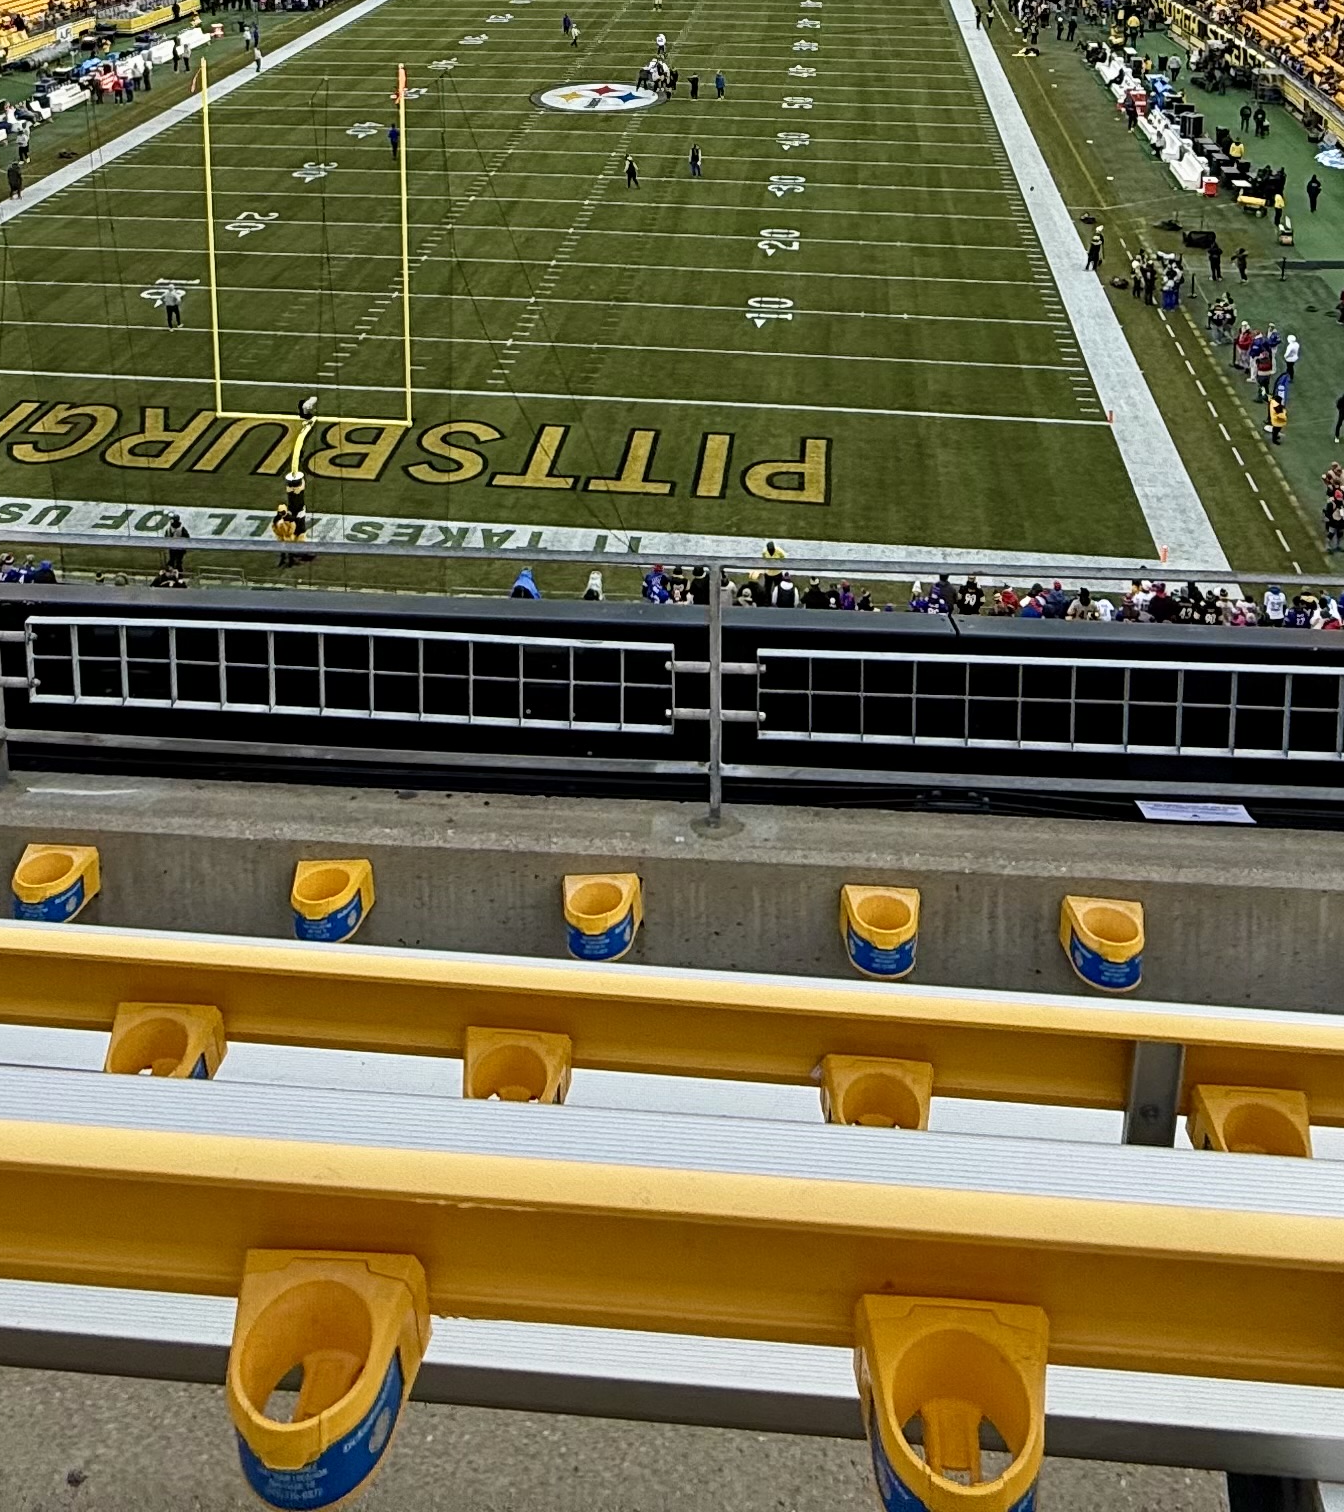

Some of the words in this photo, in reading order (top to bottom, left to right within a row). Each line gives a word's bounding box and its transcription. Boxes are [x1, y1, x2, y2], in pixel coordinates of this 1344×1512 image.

[767, 175, 806, 193] 30
[225, 211, 280, 232] 20
[757, 228, 801, 251] 20
[745, 297, 794, 321] 10
[345, 520, 549, 551] TAKES
[964, 592, 977, 607] 90
